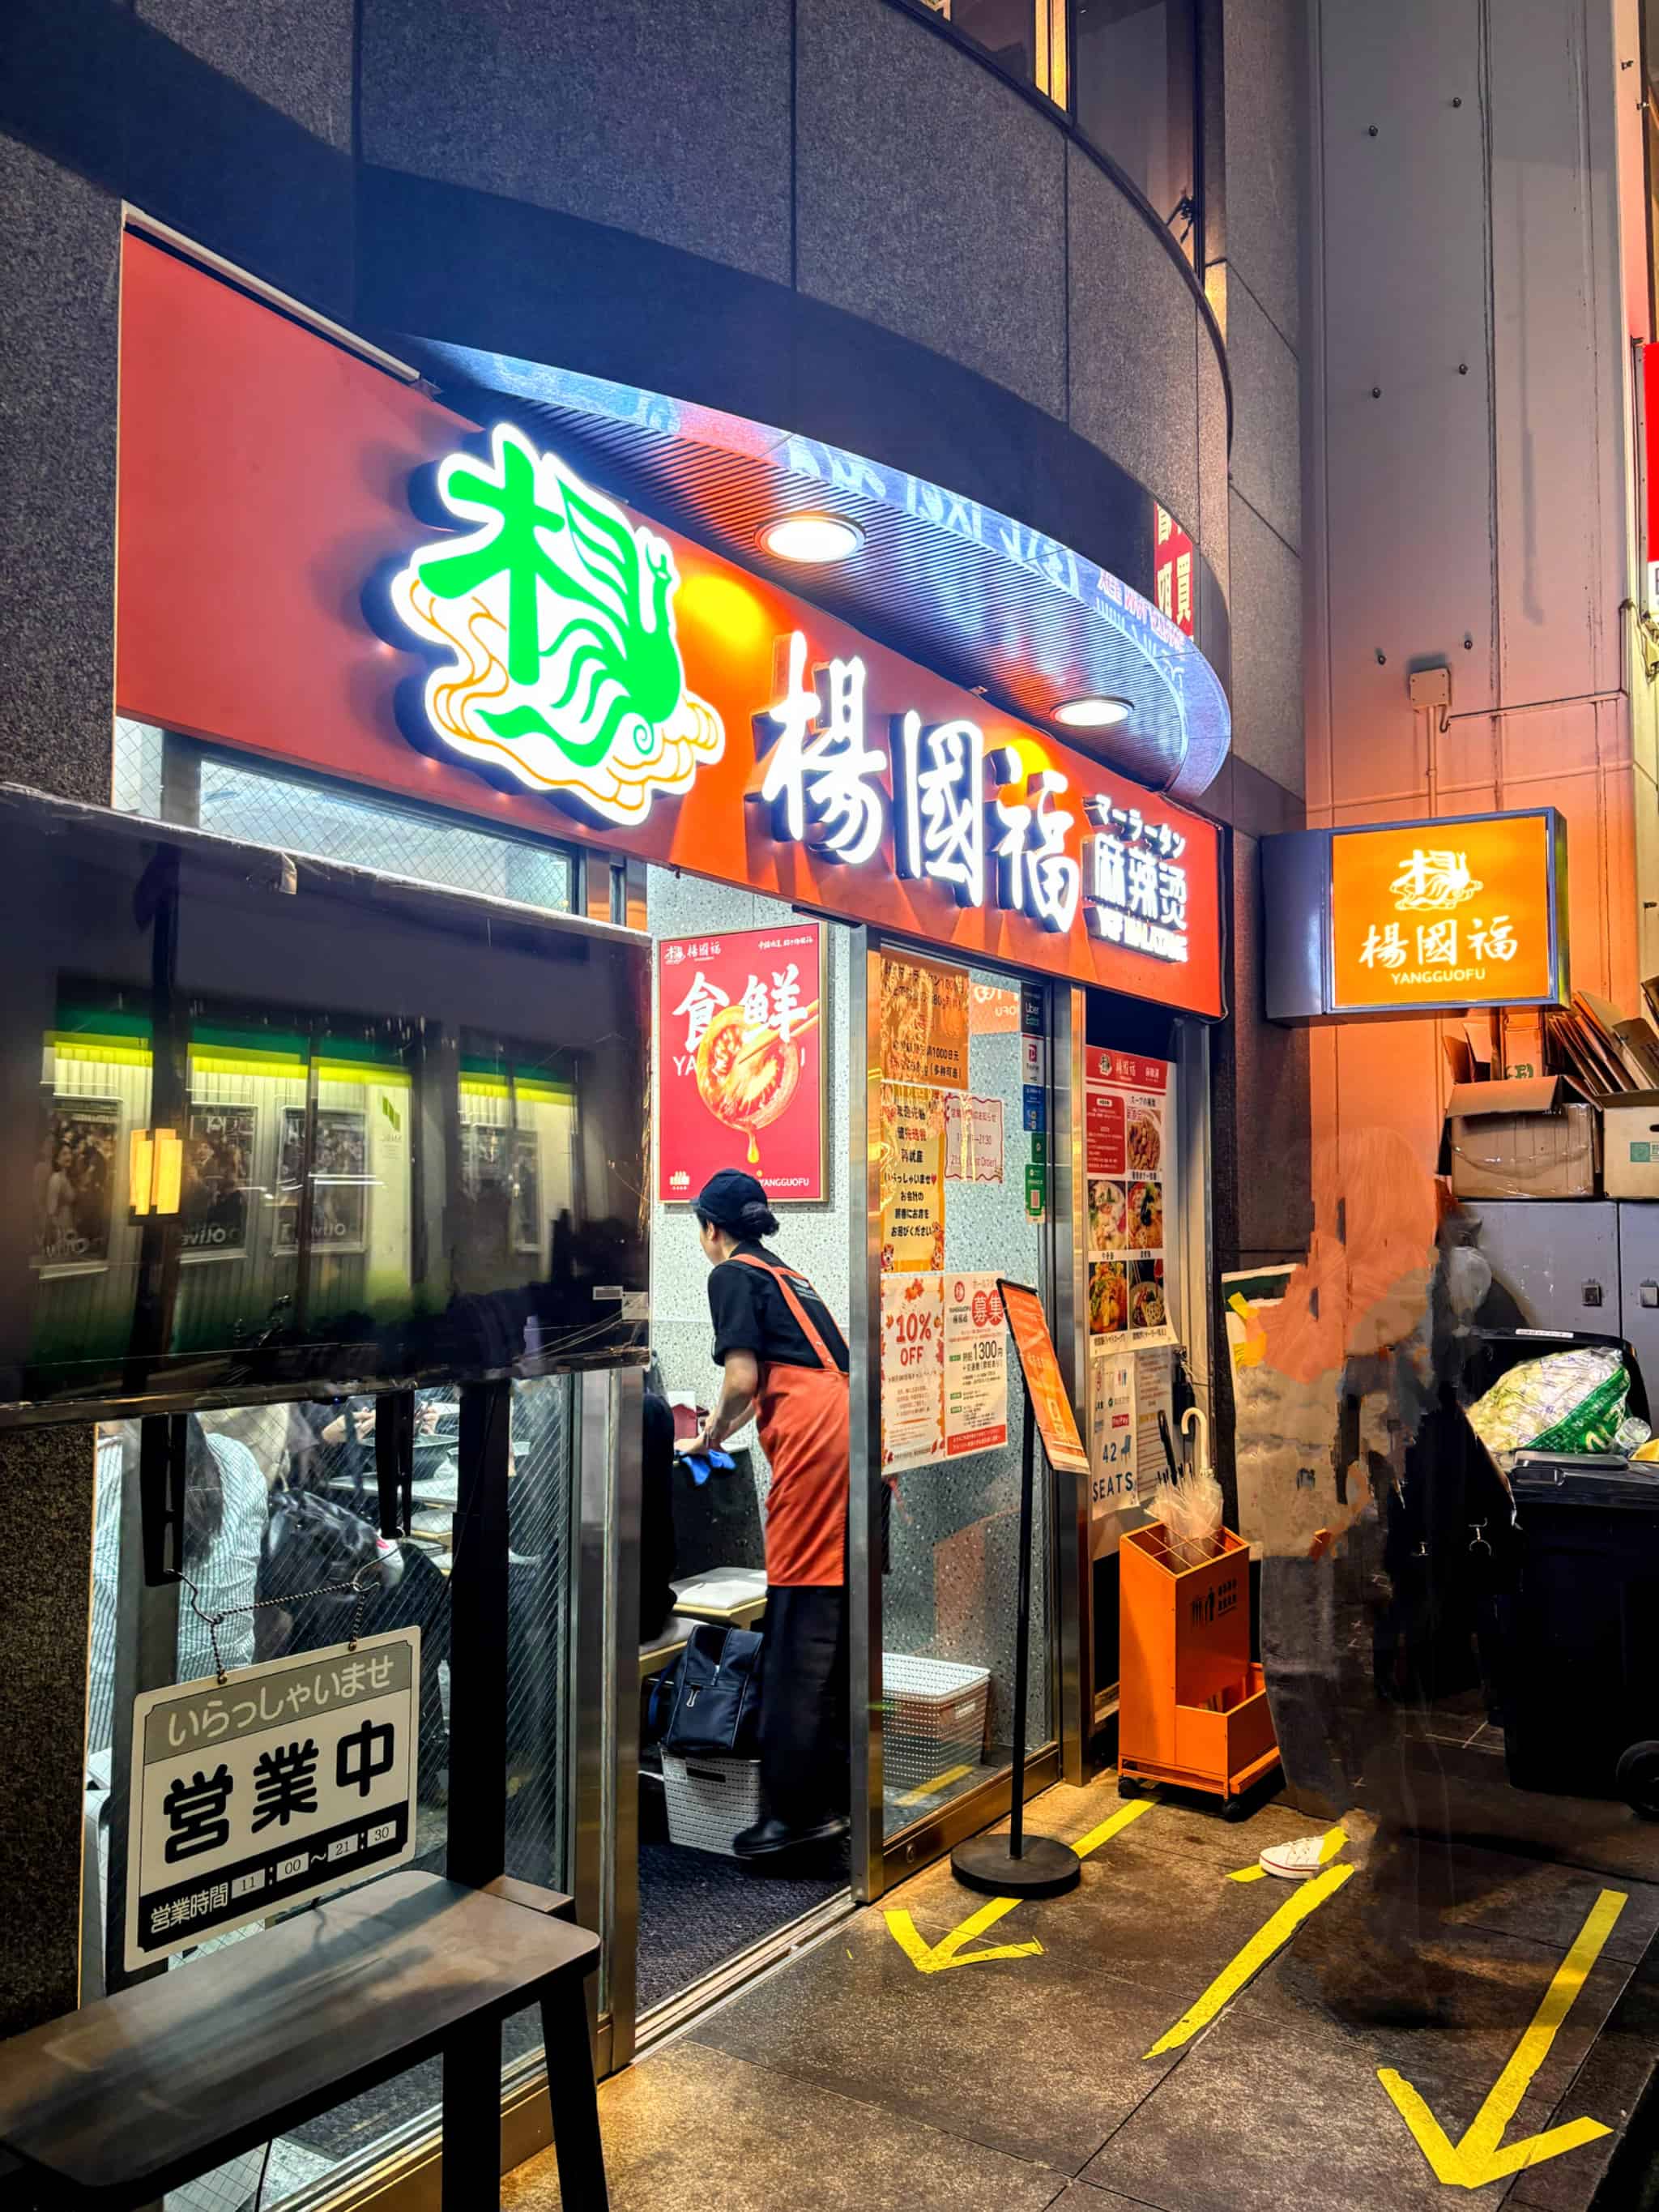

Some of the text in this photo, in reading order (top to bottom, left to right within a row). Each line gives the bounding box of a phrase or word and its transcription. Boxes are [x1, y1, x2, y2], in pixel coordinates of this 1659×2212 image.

[761, 630, 1082, 933] 楊國福
[1095, 793, 1187, 859] マーラータン
[1358, 915, 1519, 970] 楊國福
[1391, 967, 1486, 985] YANGGUOFU
[758, 1177, 810, 1187] YANGGUOFU
[974, 1294, 1004, 1324] 募集
[895, 1312, 932, 1343] 10%
[900, 1346, 924, 1366] OFF
[1102, 1441, 1117, 1463] 42
[1093, 1471, 1134, 1502] SEATS
[168, 1655, 394, 1747] いらっしゃいませ
[163, 1719, 395, 1864] 営業中
[150, 1881, 229, 1934] 営業時間
